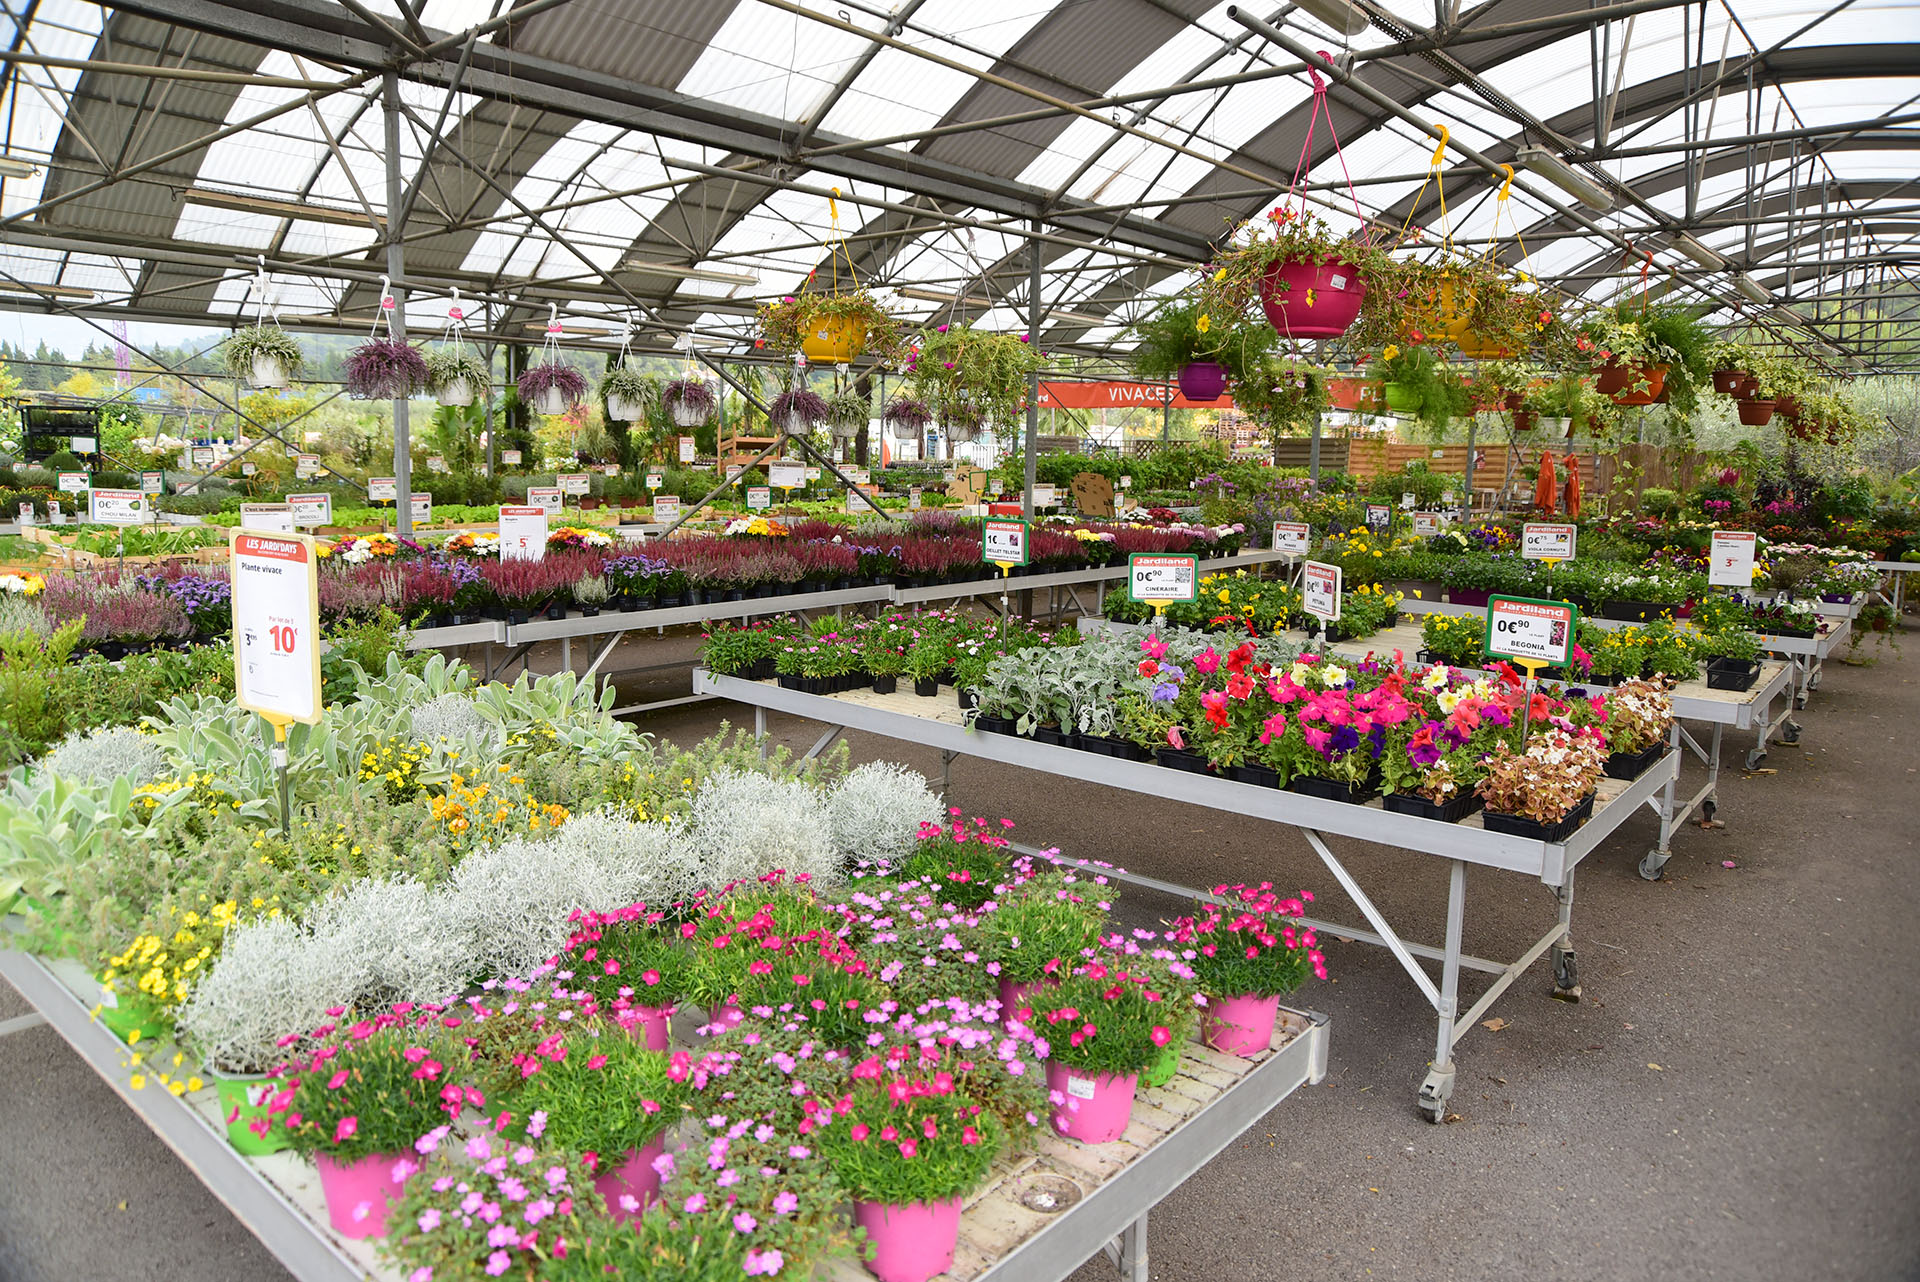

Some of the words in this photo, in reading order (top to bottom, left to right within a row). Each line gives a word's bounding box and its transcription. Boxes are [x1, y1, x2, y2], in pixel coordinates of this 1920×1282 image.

[1109, 386, 1174, 401] VIVACES
[988, 522, 1020, 530] Jardiland
[988, 534, 997, 544] 1€
[1528, 535, 1547, 544] 0€75
[246, 538, 259, 549] LES
[260, 540, 297, 554] JARDI'DAYS
[241, 562, 261, 572] Plante
[262, 565, 282, 575] vivace
[1136, 570, 1162, 582] 0€90
[1500, 602, 1564, 617] Jardiland
[1498, 620, 1530, 634] 0€90
[1511, 640, 1545, 651] BEGONIA
